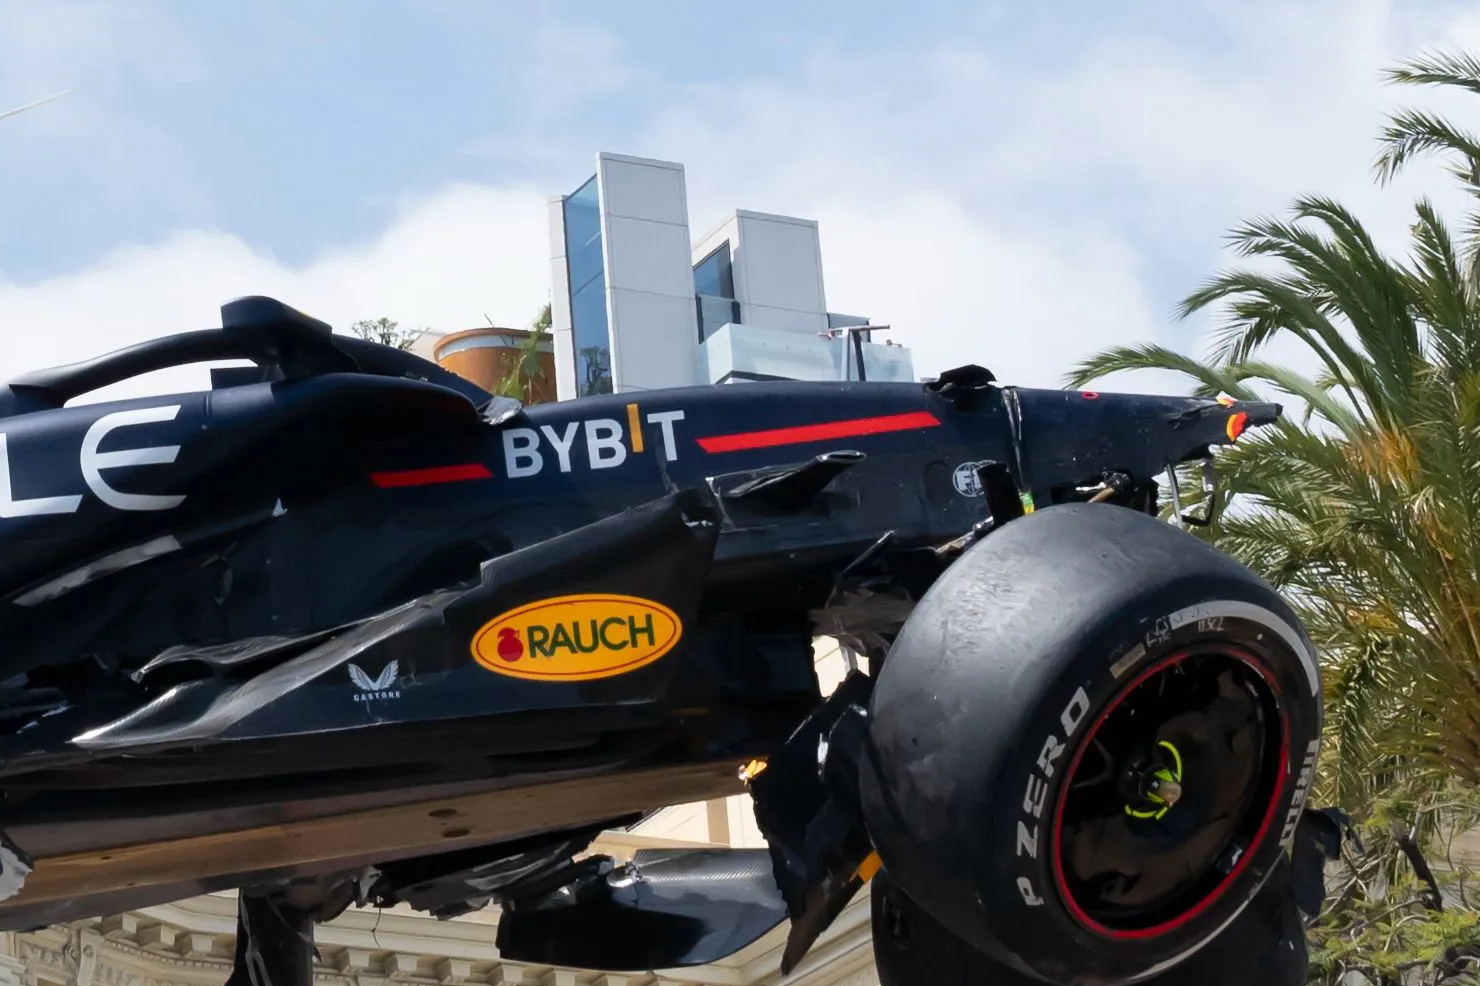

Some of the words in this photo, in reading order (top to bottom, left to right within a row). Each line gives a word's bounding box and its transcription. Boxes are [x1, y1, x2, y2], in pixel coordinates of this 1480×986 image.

[501, 403, 685, 479] BYBIT
[526, 613, 656, 658] RAUCH
[1016, 686, 1090, 858] ZERO
[1016, 876, 1044, 906] P
